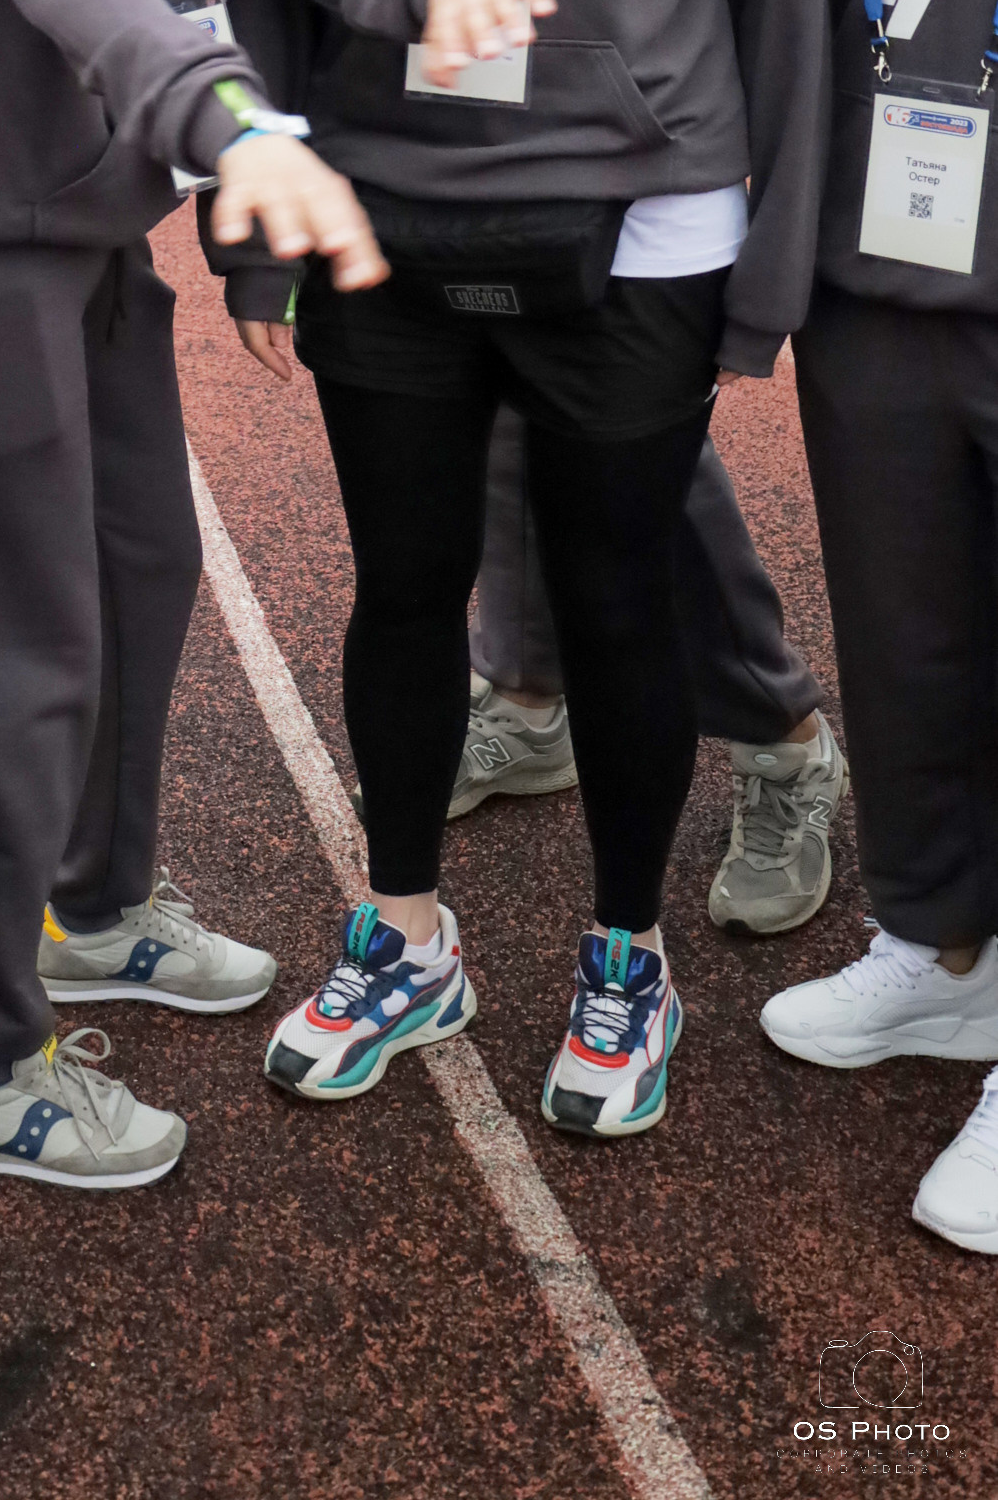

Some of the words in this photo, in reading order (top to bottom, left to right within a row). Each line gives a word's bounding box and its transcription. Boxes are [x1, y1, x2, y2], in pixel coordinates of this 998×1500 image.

[905, 156, 947, 172] Татьяна
[908, 171, 941, 186] Остер
[469, 737, 511, 770] N
[807, 795, 833, 830] N
